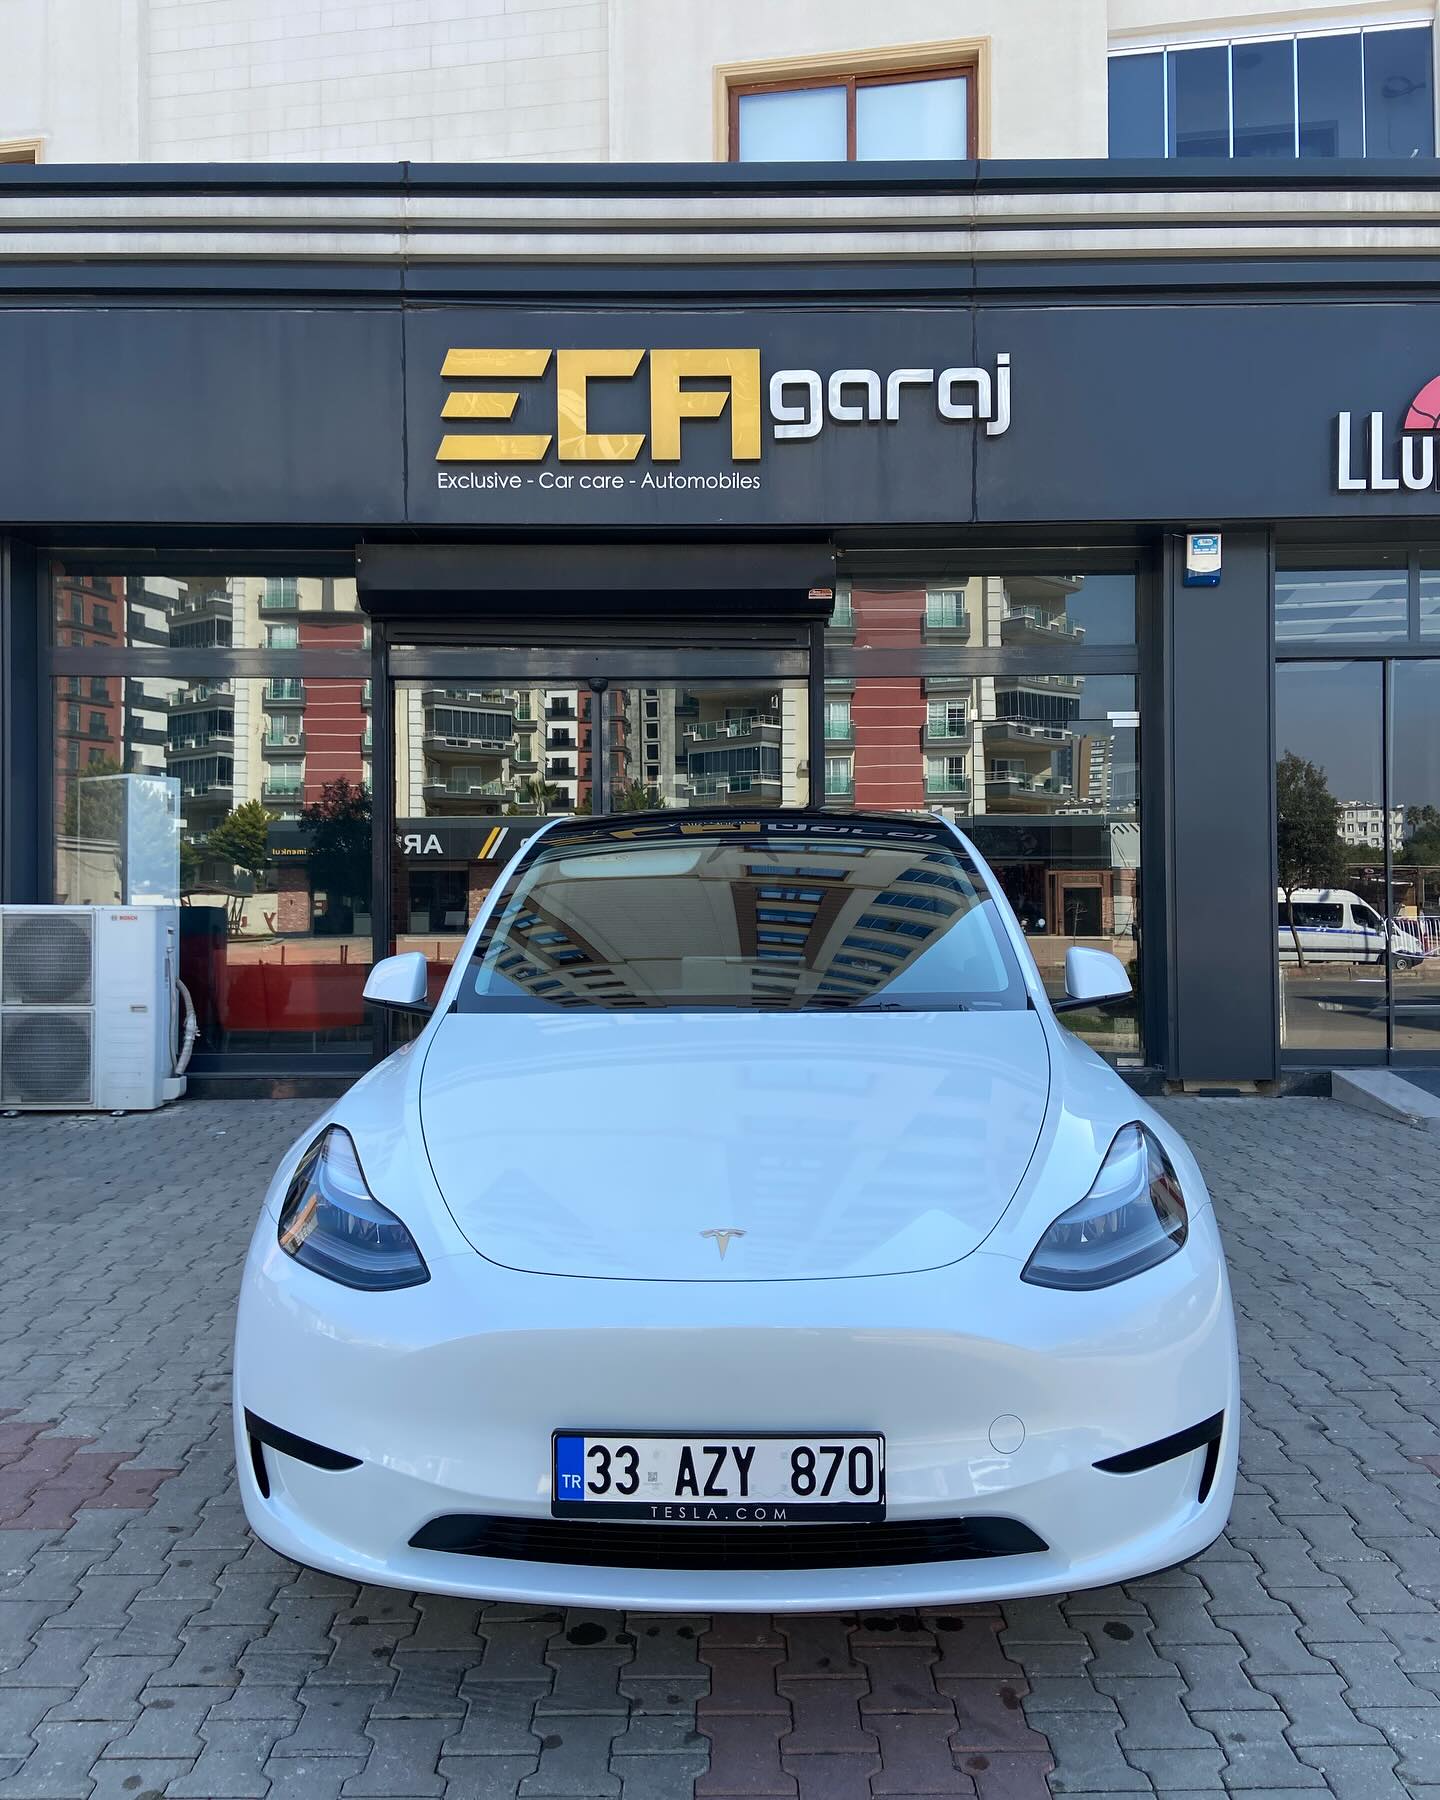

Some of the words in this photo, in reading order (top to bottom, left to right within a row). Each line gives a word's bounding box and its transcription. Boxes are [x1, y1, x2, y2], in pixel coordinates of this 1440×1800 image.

[436, 348, 761, 461] ECA
[769, 352, 1011, 439] garaj
[437, 471, 522, 489] Exclusive
[538, 471, 575, 489] Car
[579, 475, 625, 489] care
[640, 471, 761, 489] Automobiles
[561, 1474, 582, 1489] TR
[586, 1444, 641, 1495] 33
[674, 1445, 756, 1497] AZY
[790, 1446, 874, 1497] 870
